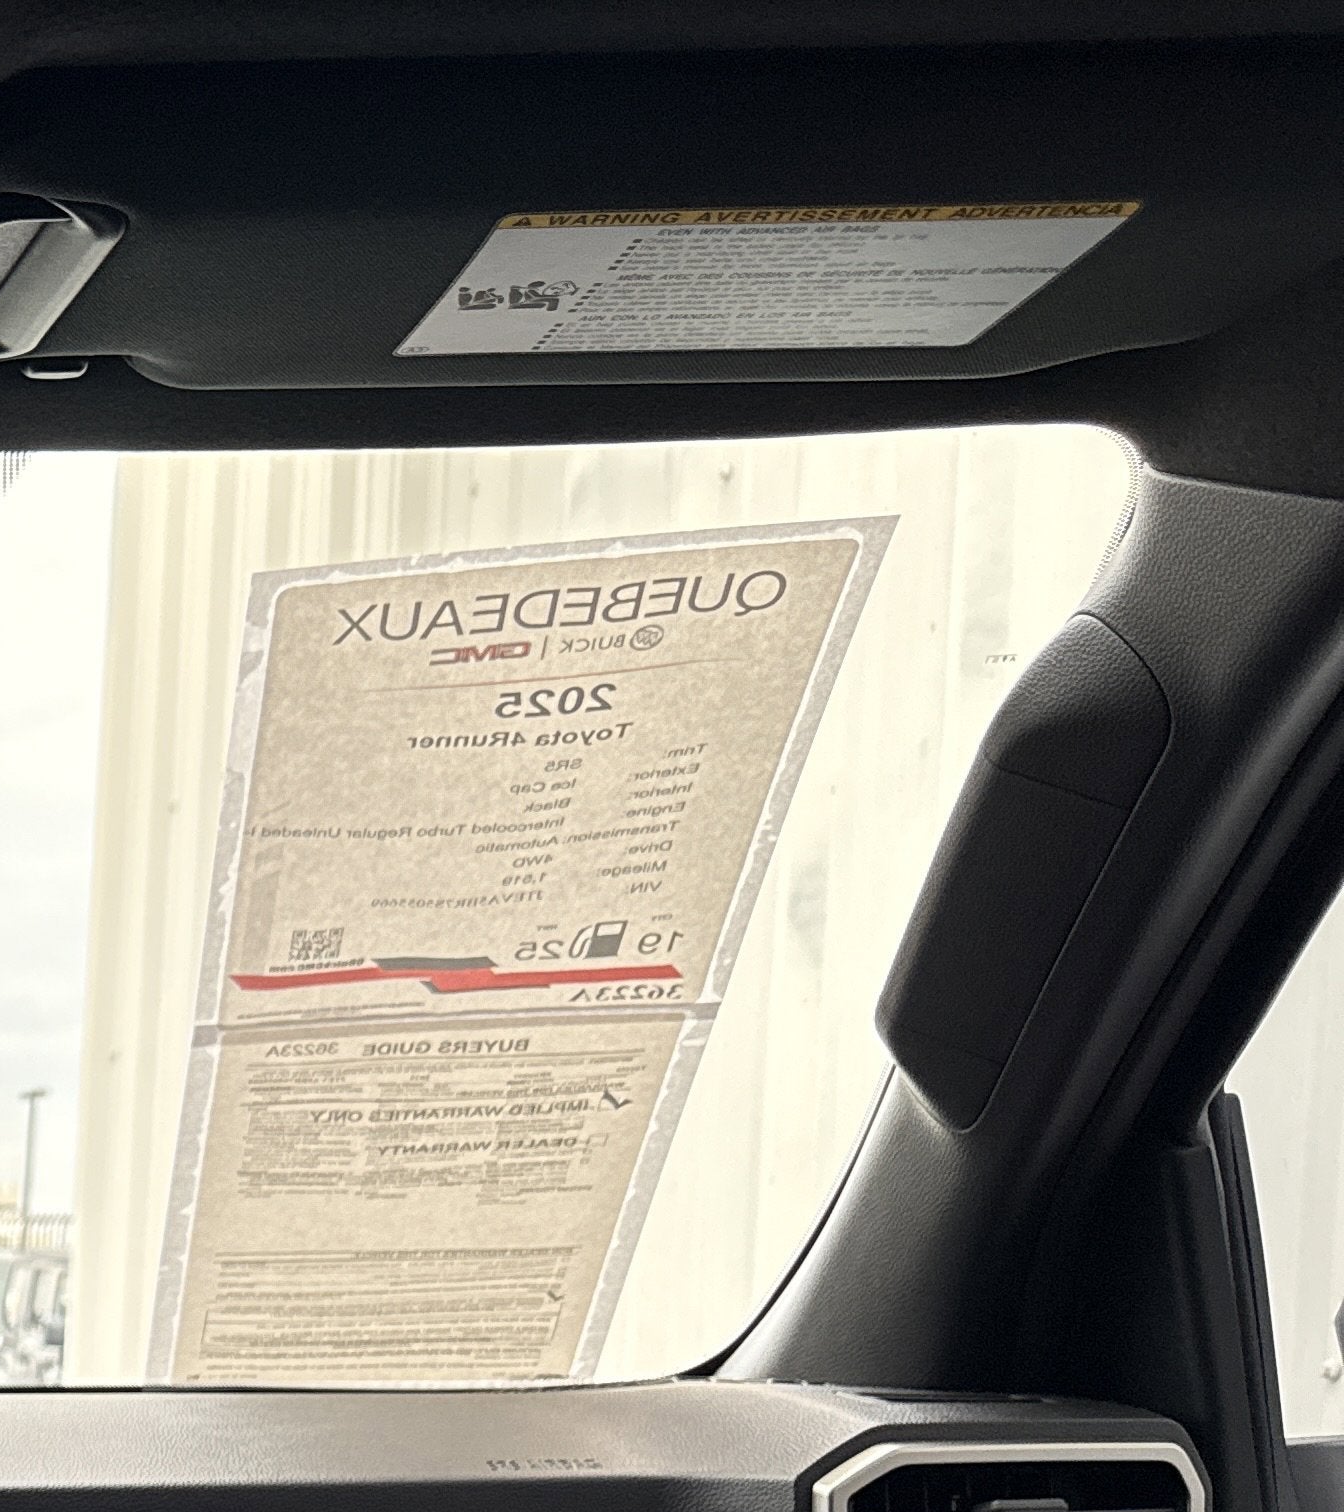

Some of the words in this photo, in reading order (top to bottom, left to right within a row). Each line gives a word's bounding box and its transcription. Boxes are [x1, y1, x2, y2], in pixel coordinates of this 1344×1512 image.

[548, 212, 681, 226] WARNING
[694, 207, 939, 223] AVERTISSEMENT
[951, 203, 1124, 218] ADVERTENCIA
